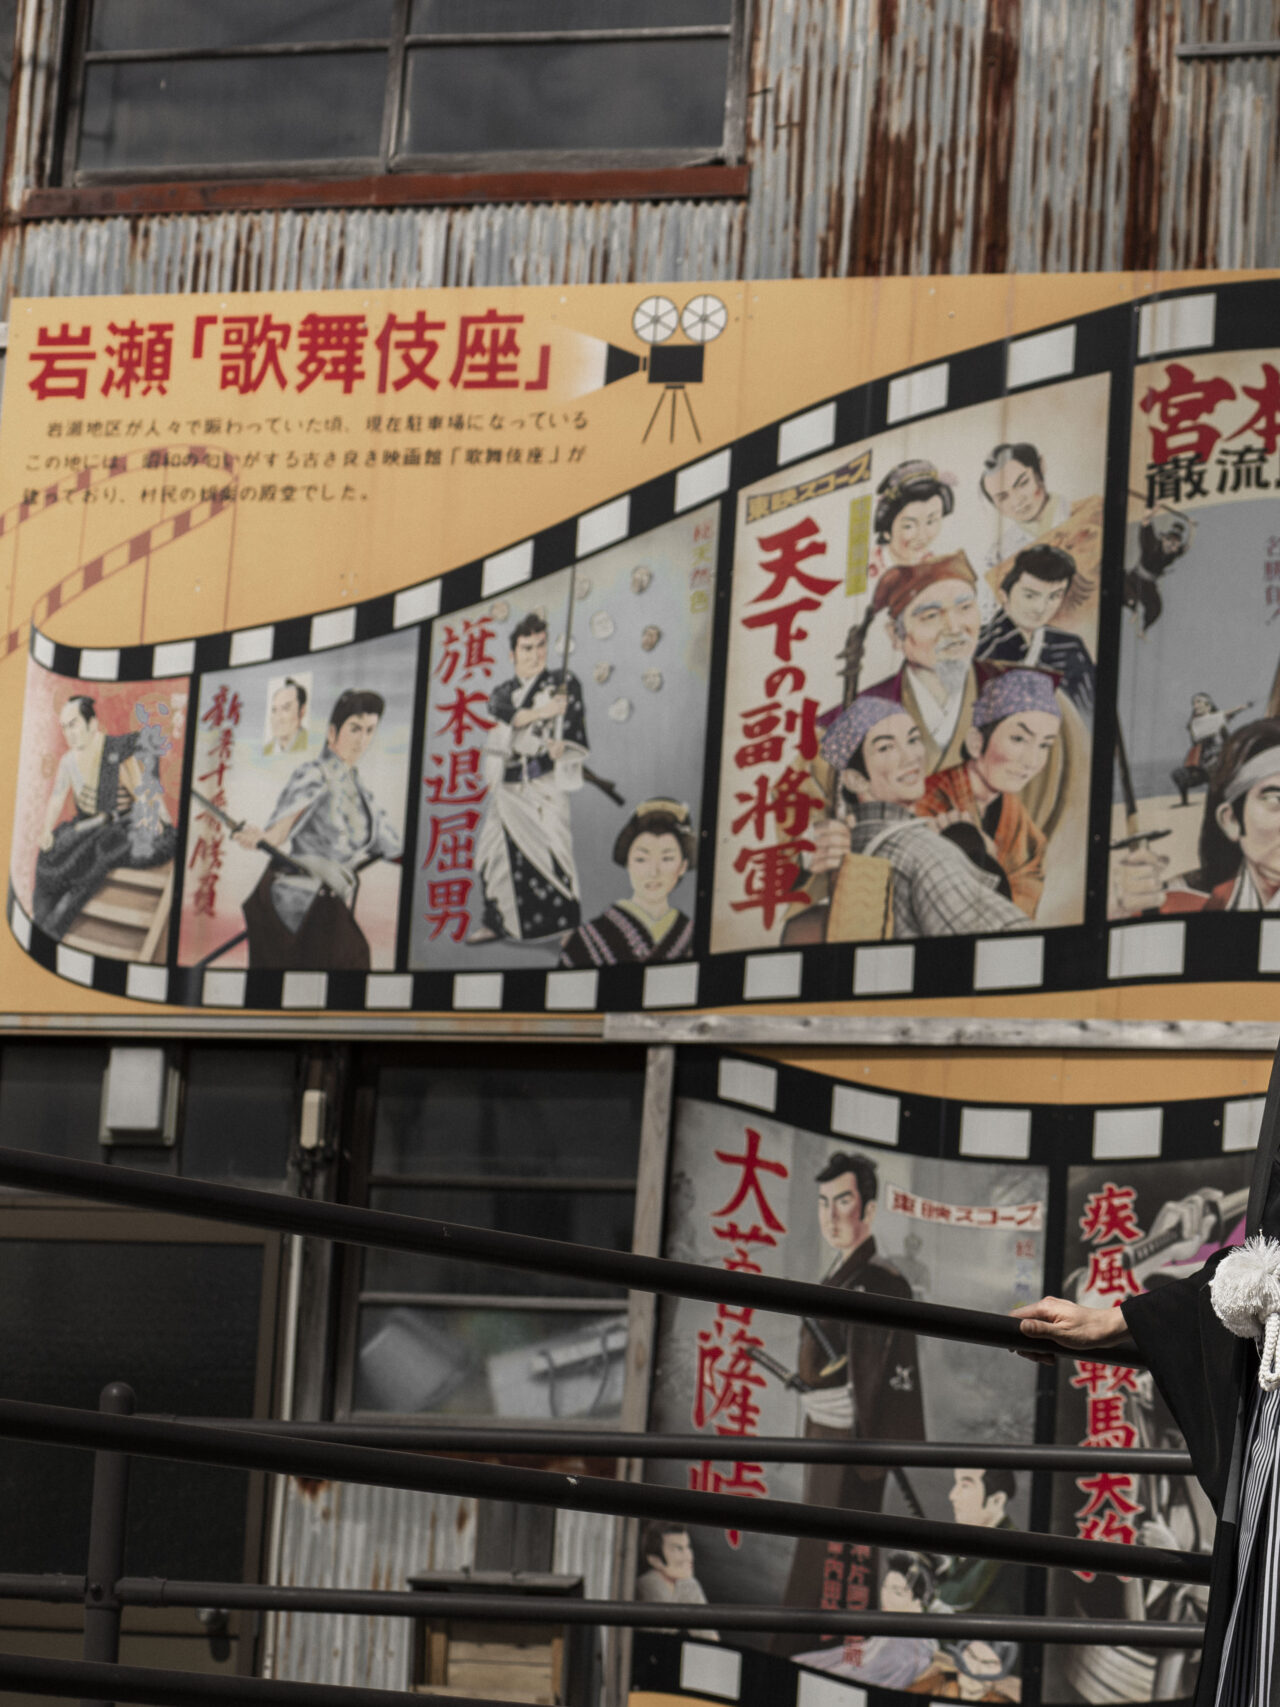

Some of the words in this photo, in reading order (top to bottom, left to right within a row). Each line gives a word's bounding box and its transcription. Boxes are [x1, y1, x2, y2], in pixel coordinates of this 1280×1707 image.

[28, 308, 551, 400] 岩瀬「歌舞伎座」
[421, 616, 498, 943] 旗本退屈男
[729, 516, 843, 931] 天下の副将軍
